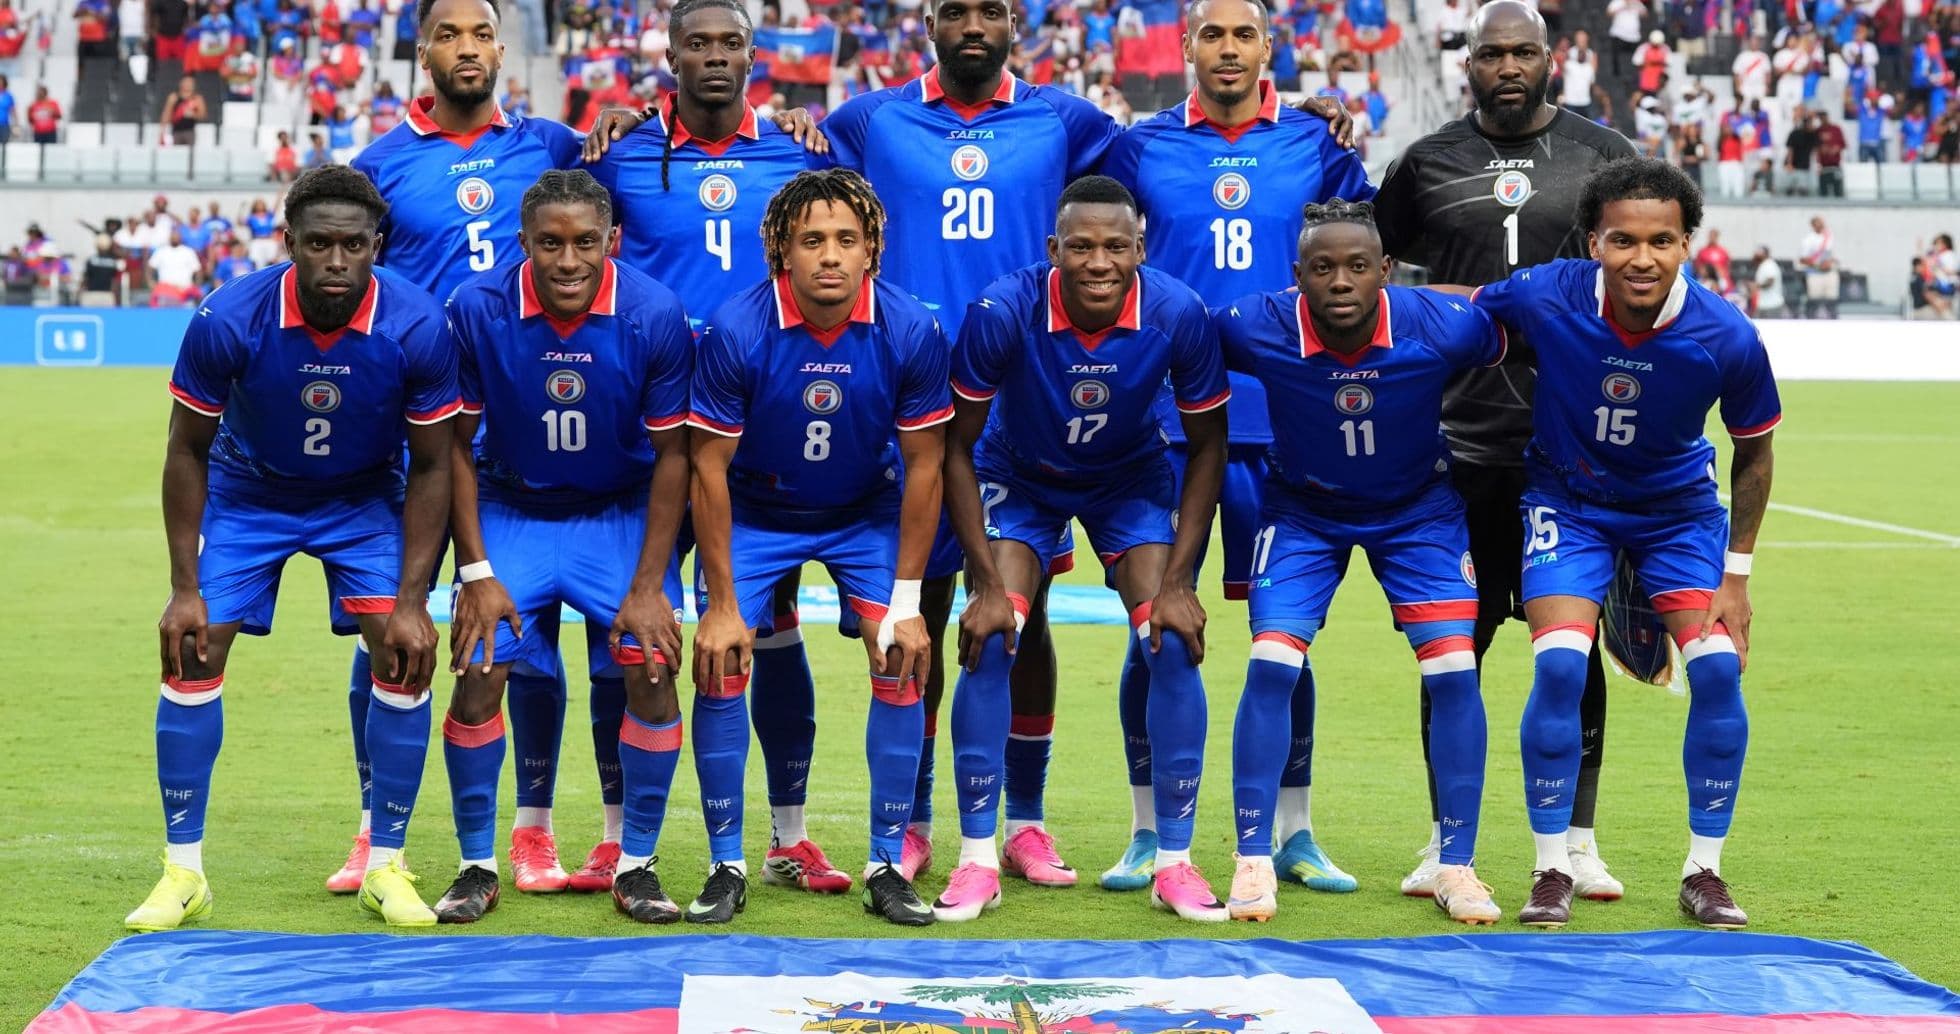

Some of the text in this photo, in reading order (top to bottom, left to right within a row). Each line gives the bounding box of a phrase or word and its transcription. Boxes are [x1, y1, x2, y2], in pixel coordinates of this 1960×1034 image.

[946, 130, 995, 140] SAETA
[447, 159, 495, 175] SAETA
[692, 160, 745, 170] SAETA
[1208, 157, 1258, 167] SAETA
[1484, 159, 1534, 169] SAETA
[942, 187, 995, 240] 20
[705, 219, 731, 271] 4
[1210, 217, 1253, 270] 18
[1503, 213, 1519, 266] 1
[466, 220, 495, 272] 5
[540, 351, 593, 363] SAETA
[298, 363, 351, 375] SAETA
[799, 362, 852, 374] SAETA
[1065, 363, 1119, 374] SAETA
[1601, 356, 1654, 372] SAETA
[1328, 369, 1380, 380] SAETA
[541, 409, 587, 452] 10
[1066, 413, 1109, 444] 17
[1593, 406, 1638, 446] 15
[303, 417, 331, 456] 2
[803, 420, 831, 462] 8
[1339, 420, 1375, 457] 11
[1526, 506, 1559, 555] 15
[1250, 525, 1276, 577] 11
[1582, 728, 1598, 738] HF
[1295, 736, 1312, 745] HF
[357, 761, 371, 771] FH
[787, 760, 809, 770] FHF
[970, 774, 995, 786] FHF
[1179, 775, 1200, 789] FHF
[1536, 778, 1565, 788] FHF
[1706, 778, 1733, 789] FHF
[165, 788, 193, 800] FHF
[387, 802, 410, 814] FHF
[707, 798, 732, 809] FHF
[885, 802, 911, 811] FHF
[1239, 808, 1261, 818] FHF
[1443, 816, 1464, 827] FHF
